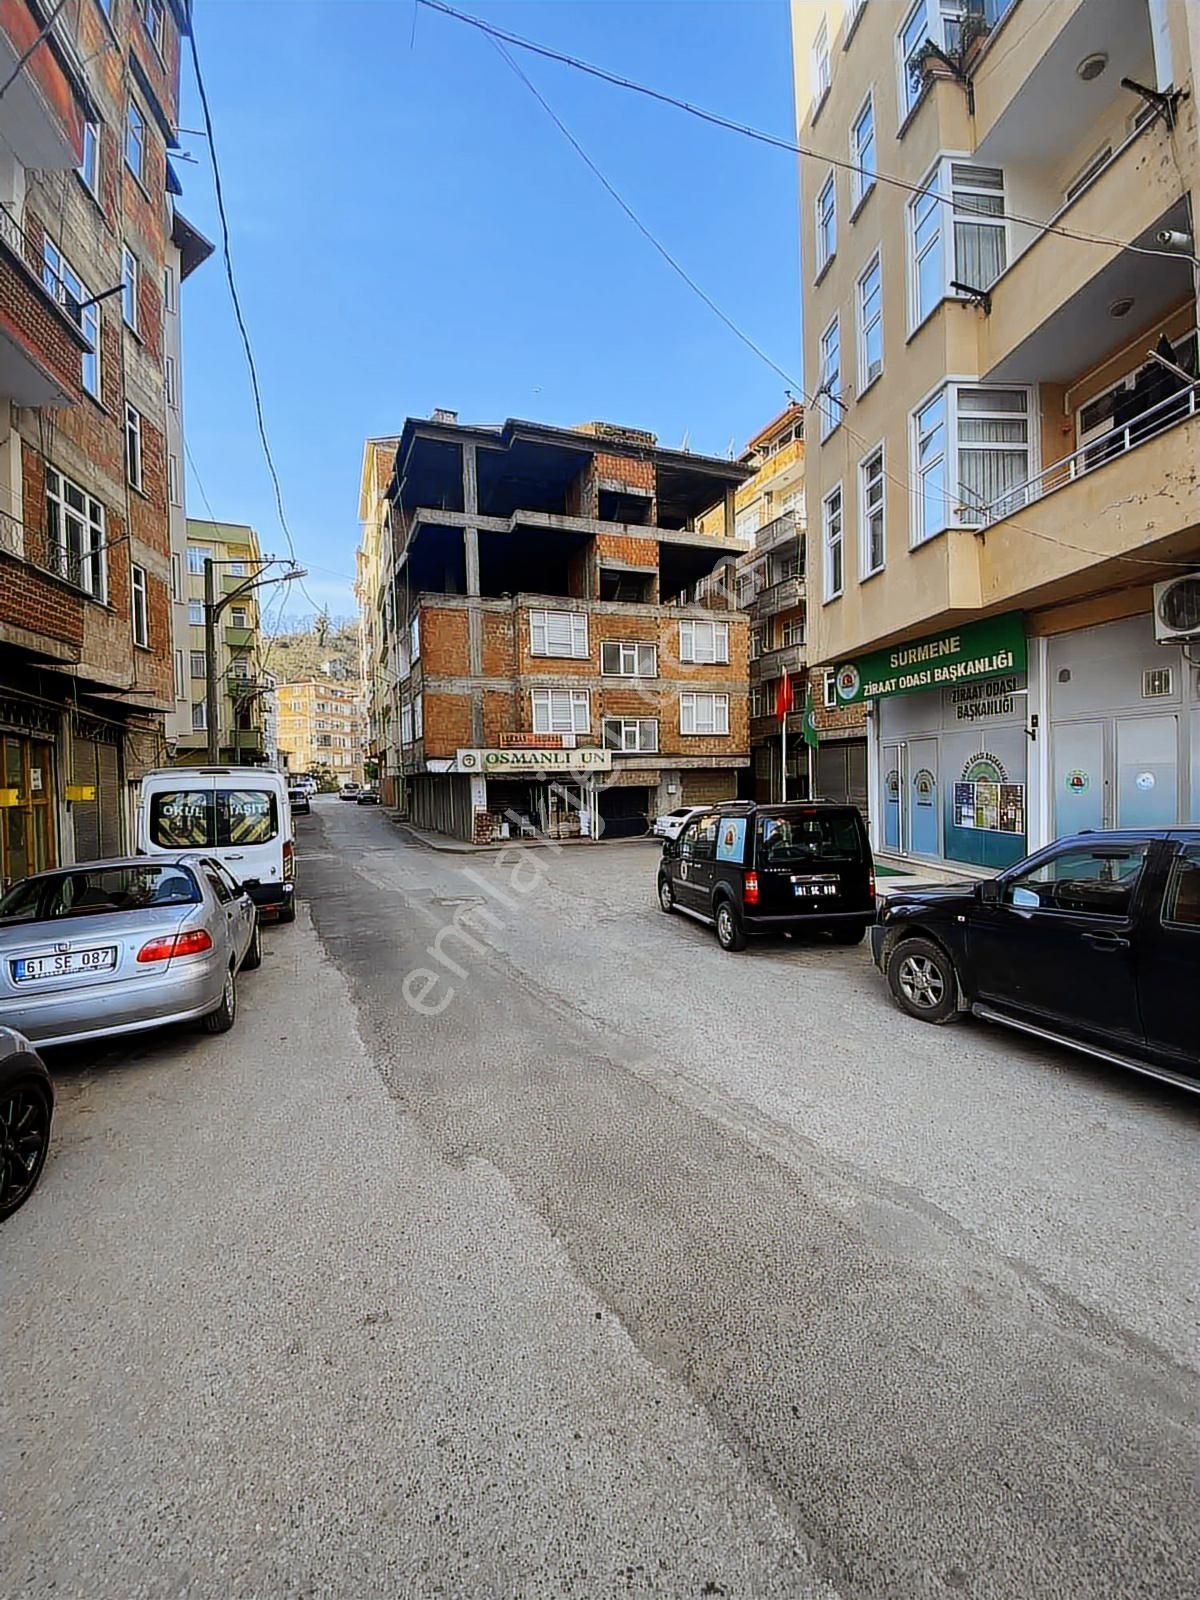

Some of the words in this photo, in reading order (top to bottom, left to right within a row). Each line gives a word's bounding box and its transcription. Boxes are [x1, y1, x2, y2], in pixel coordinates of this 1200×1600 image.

[899, 674, 931, 689] ODASI
[934, 650, 1014, 682] BAŞKANLIĞI
[985, 677, 1017, 698] ODASI
[486, 752, 570, 765] OSMANLI
[581, 752, 605, 764] UN
[27, 960, 43, 974] 61
[55, 955, 72, 970] SE
[82, 950, 110, 966] 087
